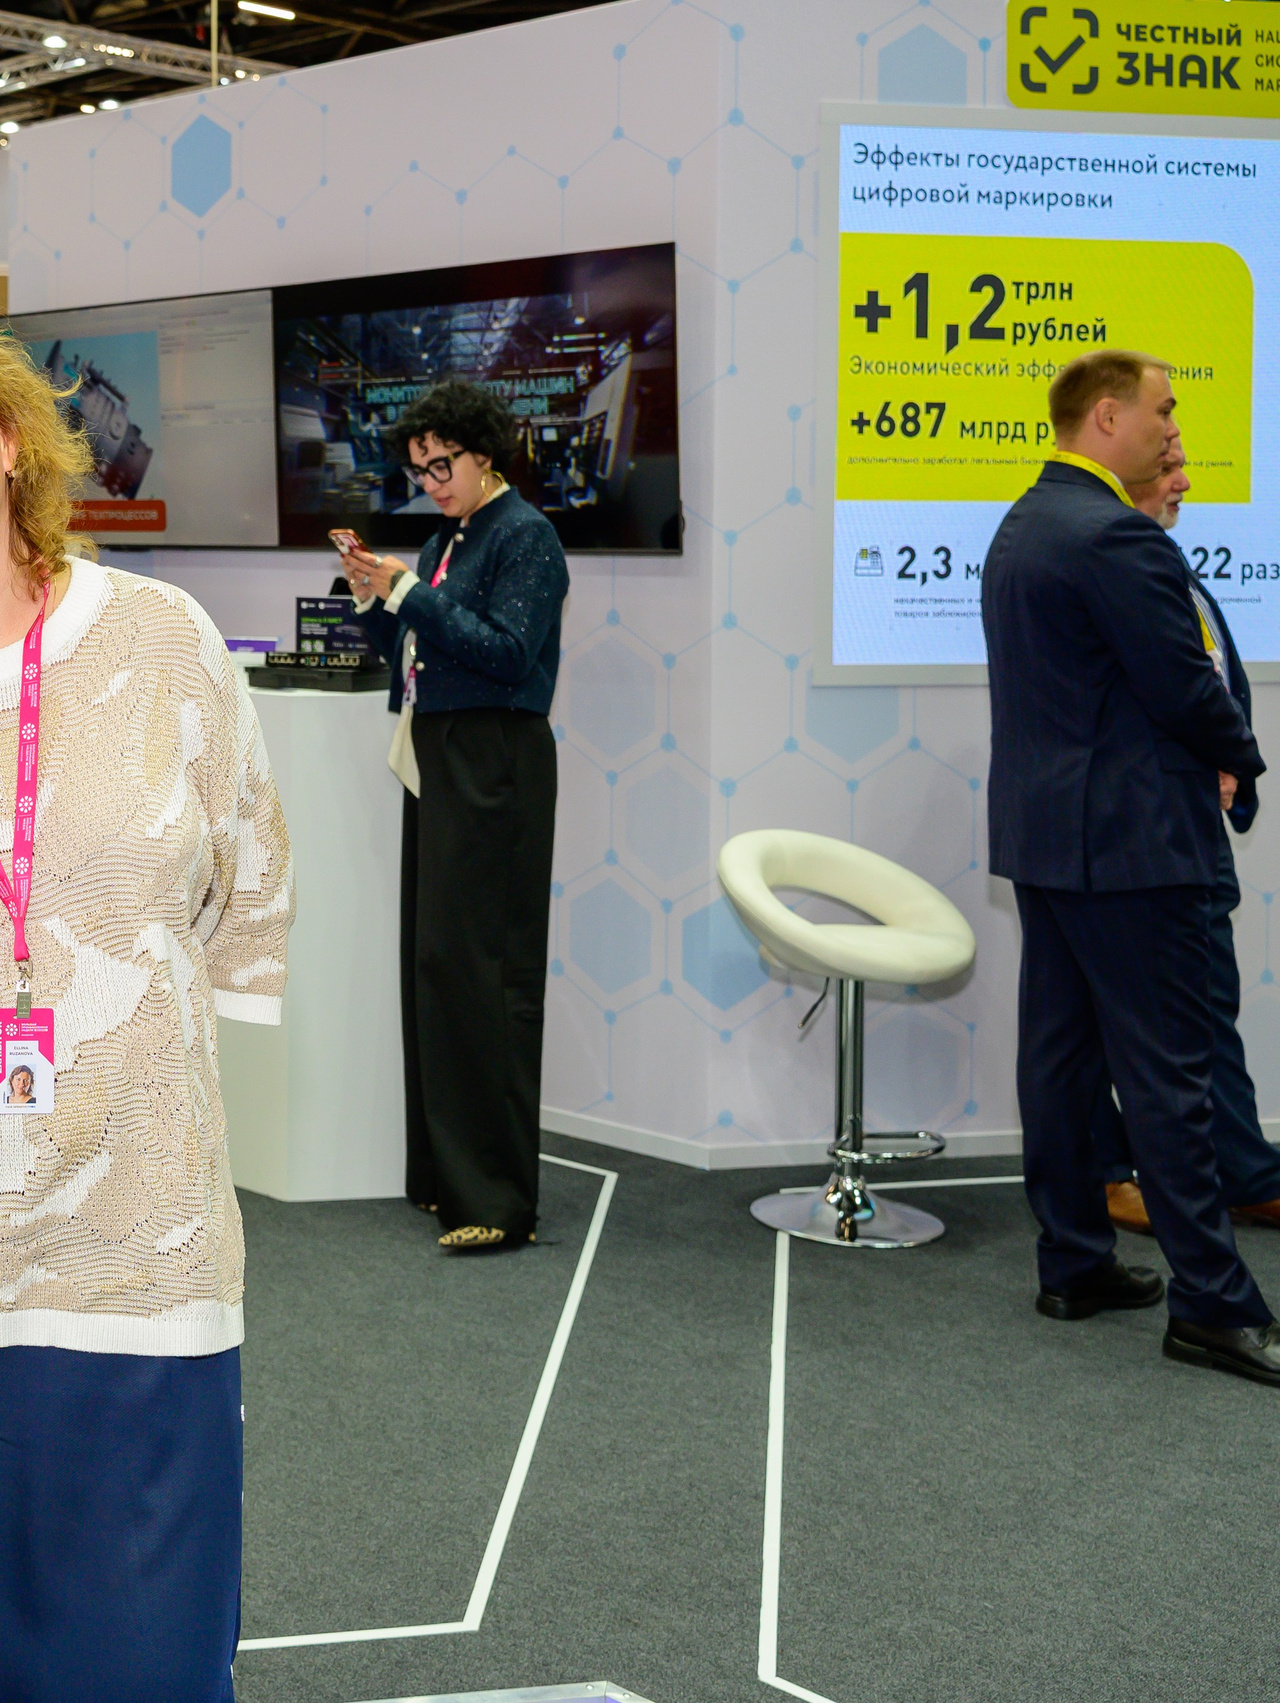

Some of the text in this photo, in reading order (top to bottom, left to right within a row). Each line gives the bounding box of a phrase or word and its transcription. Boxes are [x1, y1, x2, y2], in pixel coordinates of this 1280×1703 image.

[1116, 23, 1242, 47] ЧЕСТНЫЙ
[1116, 51, 1241, 90] ЗНАК
[853, 142, 1257, 178] Эффекты государственной системы
[853, 182, 1113, 211] цифровой маркировки
[854, 272, 1073, 355] +1,2 трлн
[1013, 317, 1107, 347] рублей
[849, 355, 1010, 377] Экономический
[851, 401, 946, 438] +687
[960, 420, 1026, 445] млрд
[897, 545, 952, 586] 2,3
